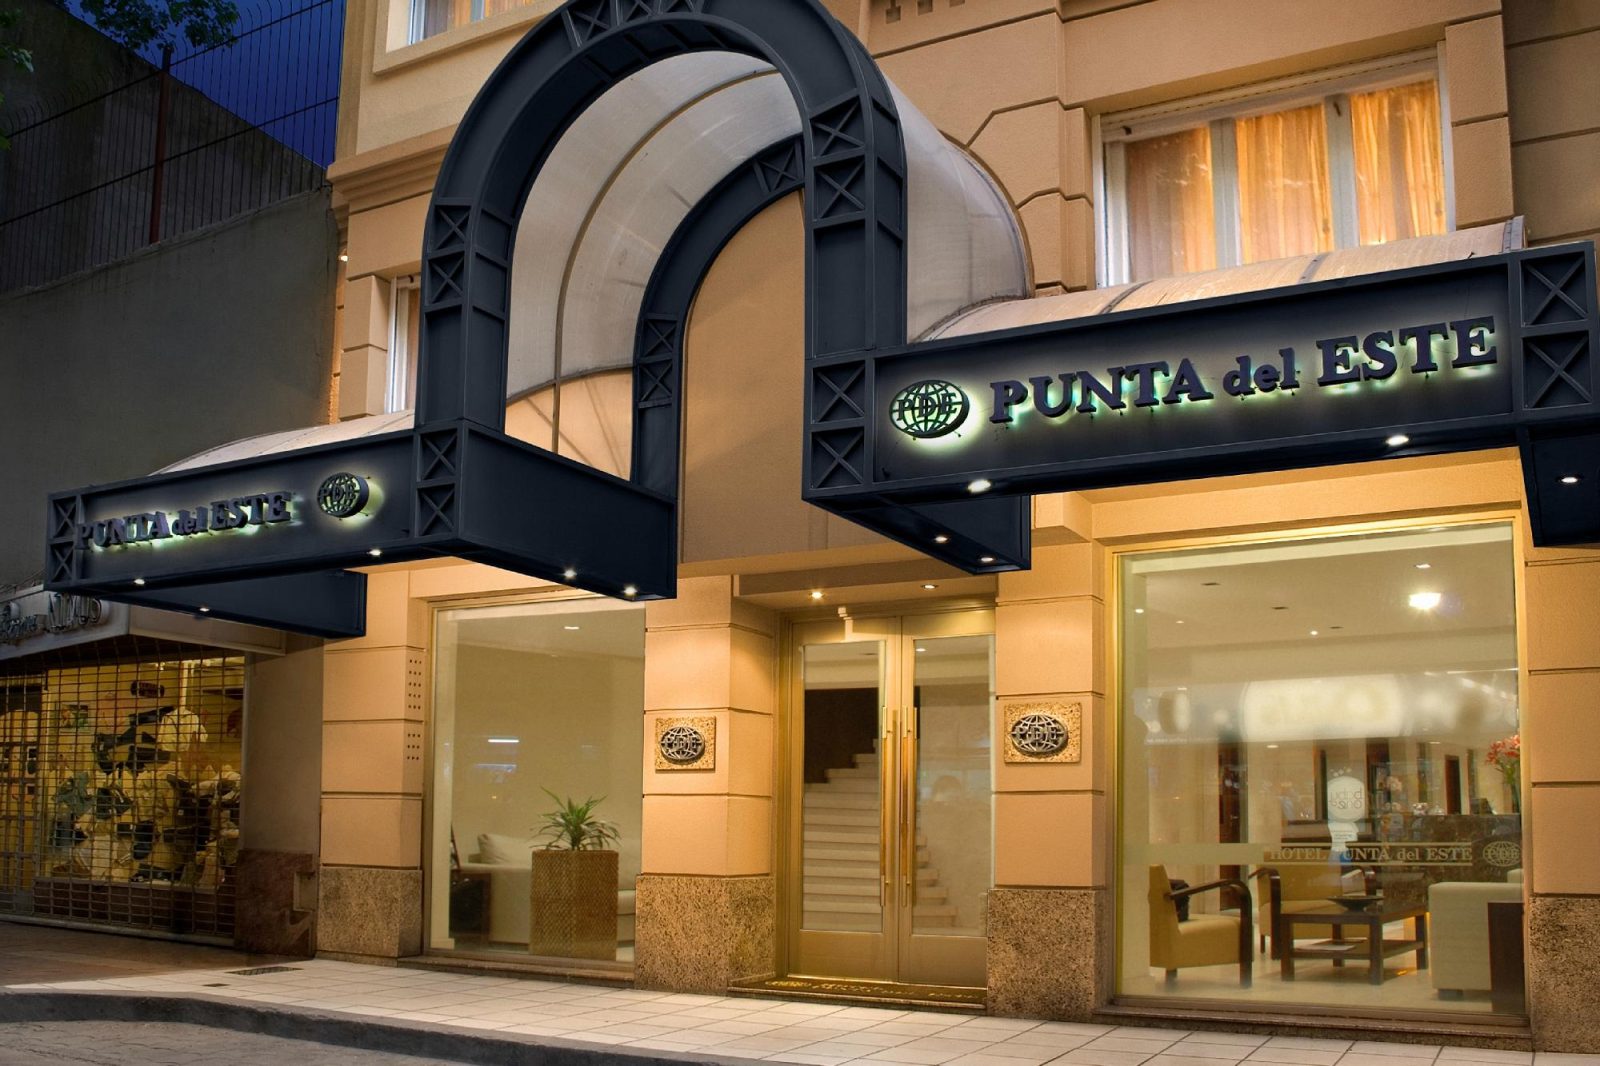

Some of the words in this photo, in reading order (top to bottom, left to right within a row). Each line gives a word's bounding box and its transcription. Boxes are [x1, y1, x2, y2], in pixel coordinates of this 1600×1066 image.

[989, 358, 1214, 423] PUNTA
[1222, 347, 1300, 396] del
[1316, 316, 1497, 386] ESTE
[896, 392, 957, 421] PDE
[74, 511, 173, 550] PUNTA
[172, 506, 209, 535] del
[210, 491, 292, 531] ESTE
[1270, 847, 1326, 861] HOTEL
[1335, 847, 1391, 861] UNTA
[1397, 847, 1420, 861] del
[1426, 847, 1473, 861] ESTE
